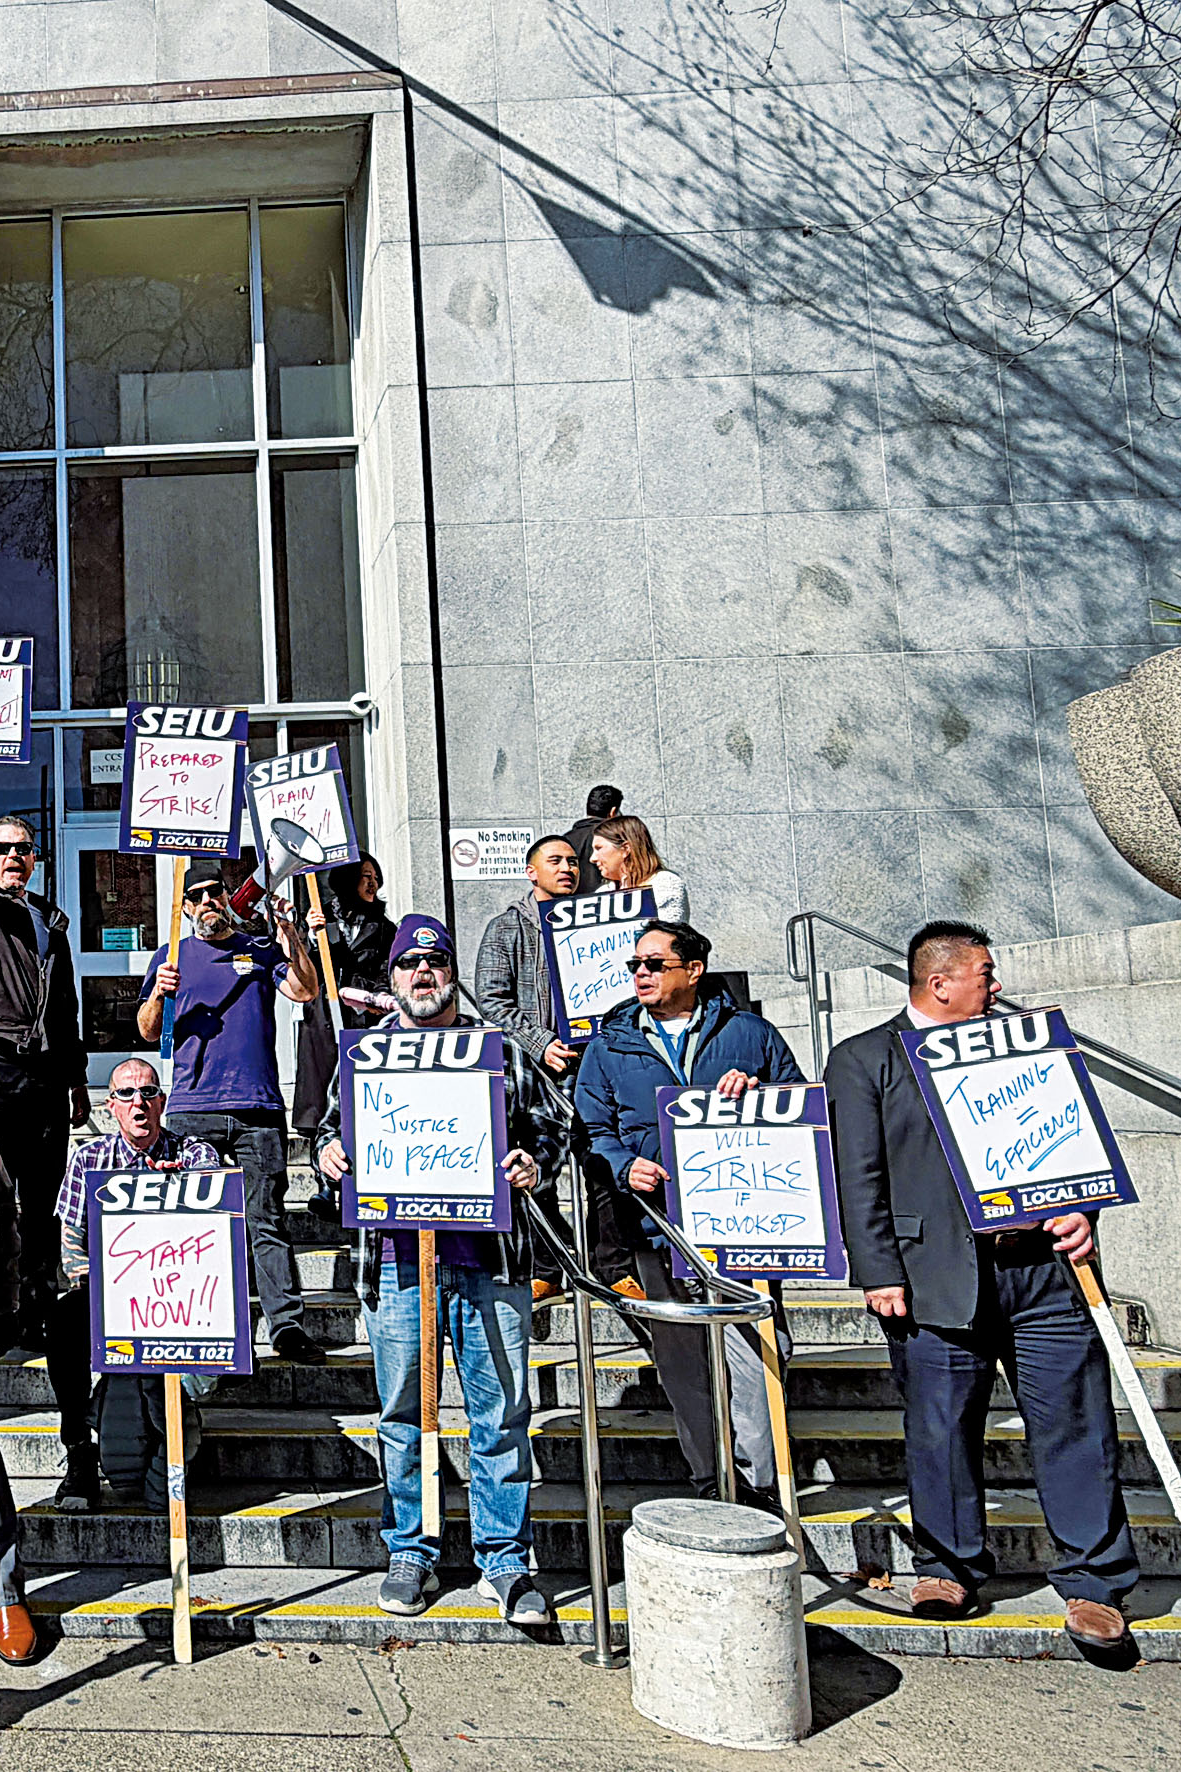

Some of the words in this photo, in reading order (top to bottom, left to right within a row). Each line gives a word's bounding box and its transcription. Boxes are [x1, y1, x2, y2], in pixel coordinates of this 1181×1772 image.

[137, 706, 235, 737] SEIU
[93, 765, 121, 773] ENTRA
[105, 753, 123, 762] CCS
[139, 742, 223, 770] PREPARED
[253, 749, 327, 788] SEIU
[169, 771, 189, 786] TO
[139, 784, 224, 820] STRIKE!
[259, 785, 315, 808] TRAIN
[158, 835, 197, 846] LOCAL
[202, 836, 227, 848] 1021
[478, 831, 491, 842] No
[493, 830, 531, 844] Smoking
[552, 890, 641, 930] SEIU
[558, 929, 633, 966] TRAININ
[569, 969, 633, 1010] EFFICIE
[355, 1032, 485, 1070] SEIU
[925, 1012, 1050, 1069] SEIU
[674, 1087, 806, 1126] SEIU
[945, 1062, 1054, 1126] TRAINING
[381, 1104, 459, 1134] JUSTICE
[715, 1130, 771, 1150] WILL
[986, 1098, 1080, 1181] EFFICIENCY
[406, 1132, 487, 1176] PEACE!
[683, 1151, 811, 1196] STRIKE
[103, 1173, 226, 1211] SEIU
[736, 1192, 751, 1206] IF
[1022, 1186, 1077, 1208] LOCAL
[1081, 1180, 1116, 1201] 1021
[357, 1210, 387, 1220] SEIU
[395, 1202, 451, 1216] LOCAL
[457, 1204, 493, 1217] 1021
[983, 1205, 1015, 1219] SEIU
[691, 1212, 806, 1237] PROVOKED
[109, 1222, 215, 1284] STAFF
[727, 1254, 777, 1266] LOCAL
[788, 1254, 825, 1267] 1021
[153, 1272, 181, 1297] UP
[130, 1275, 219, 1331] NOW!!
[105, 1355, 134, 1364] SEIU
[143, 1347, 194, 1360] LOCAL
[199, 1347, 234, 1360] 1021
